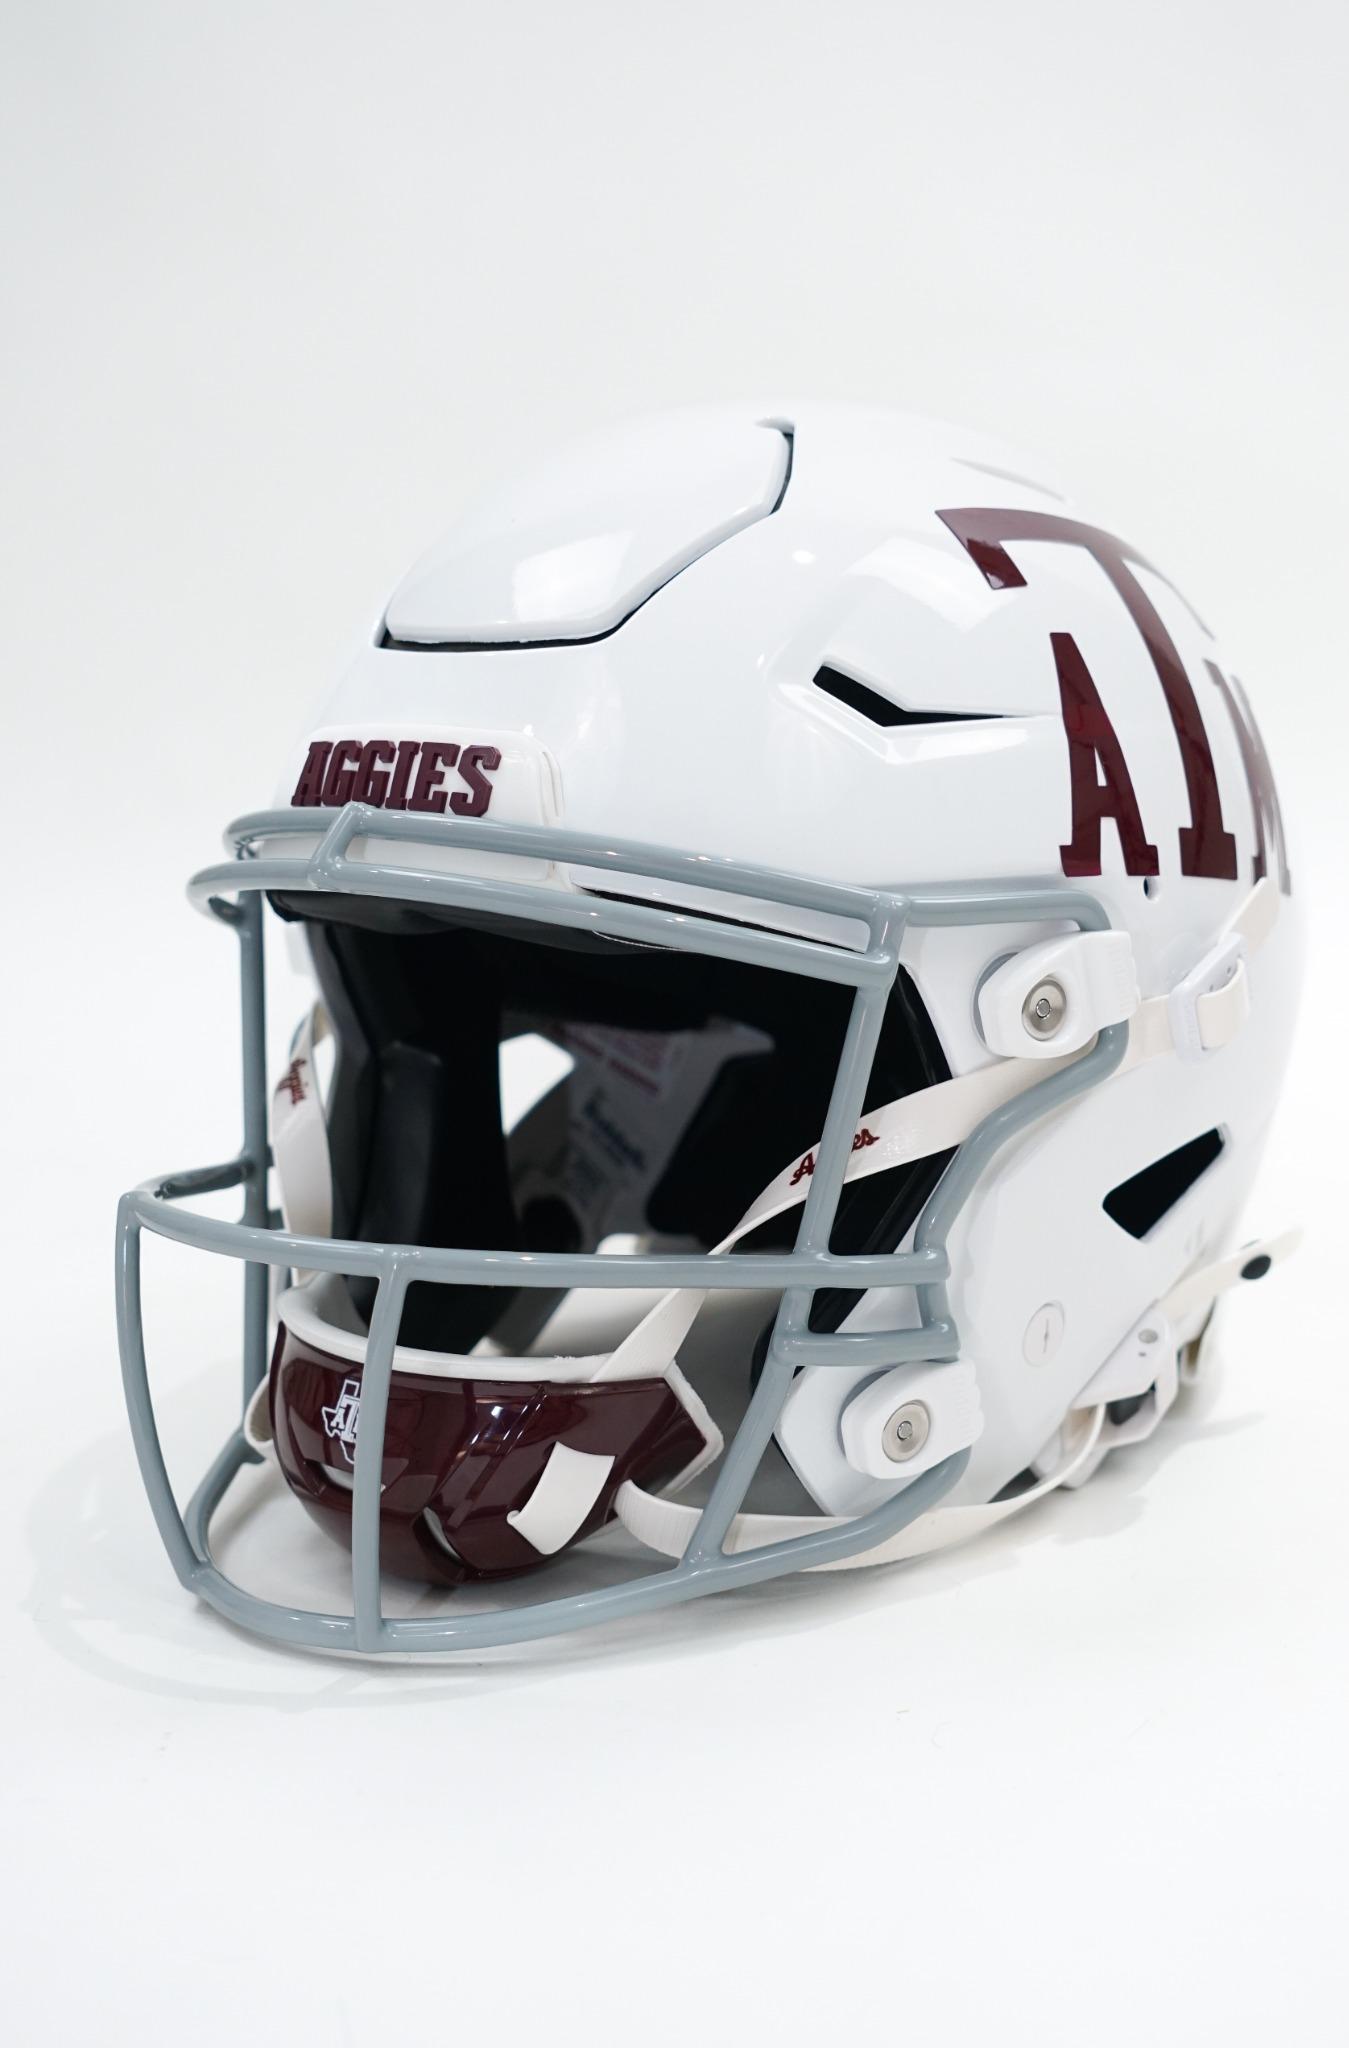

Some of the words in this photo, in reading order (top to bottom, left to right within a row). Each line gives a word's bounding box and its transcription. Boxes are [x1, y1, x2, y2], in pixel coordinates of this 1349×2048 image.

[291, 740, 502, 817] AGGIES
[789, 1128, 881, 1186] Aes
[330, 1394, 360, 1443] AT
